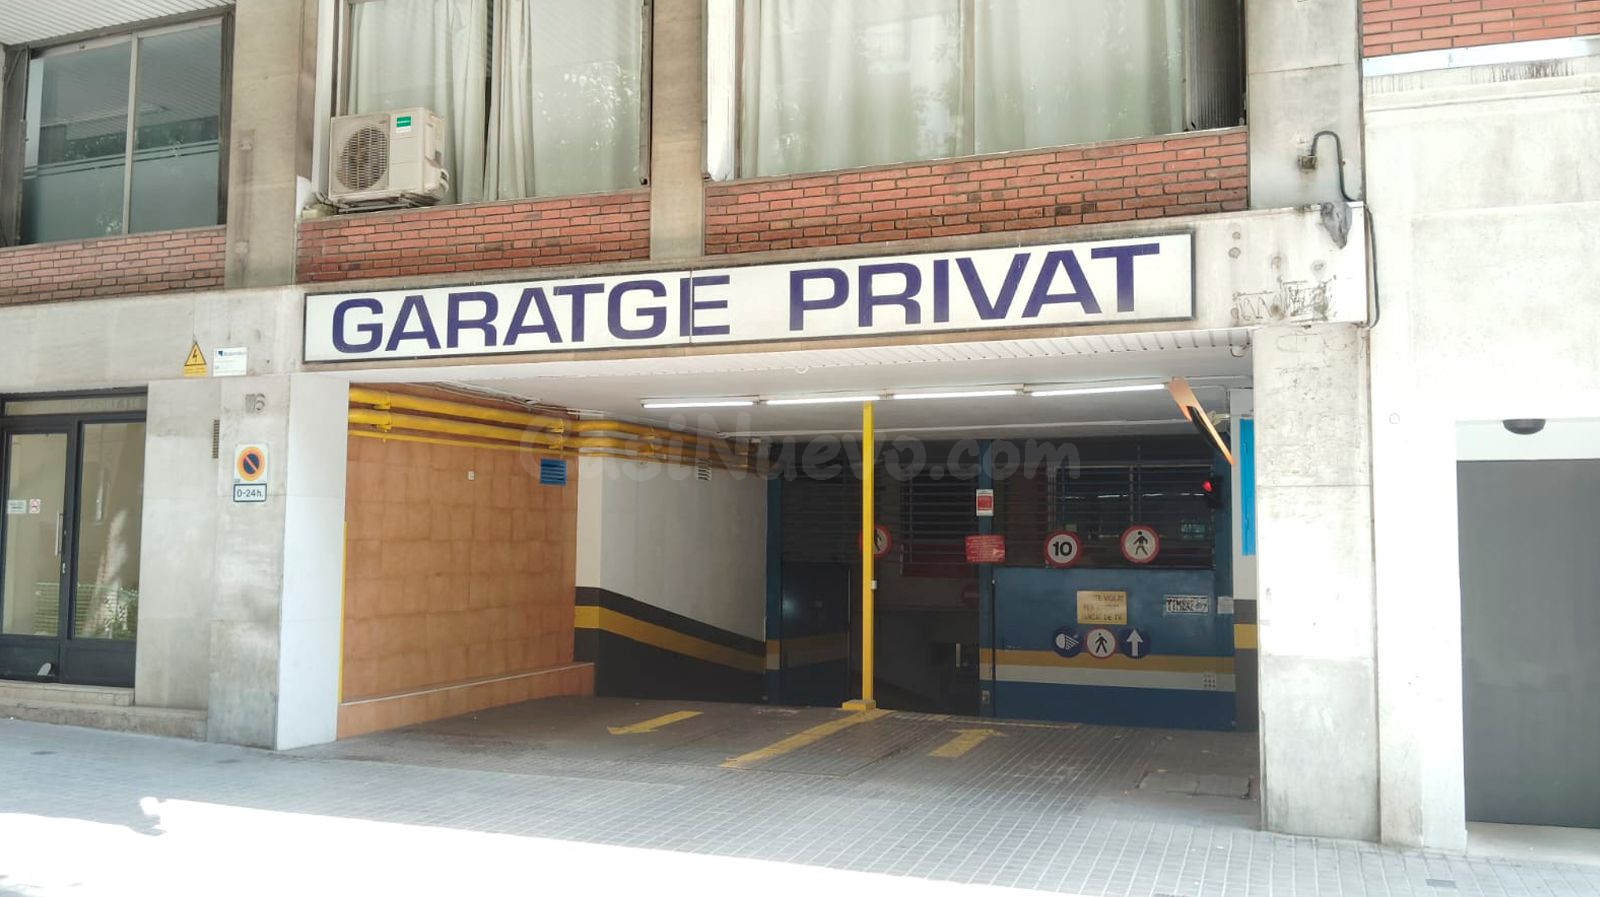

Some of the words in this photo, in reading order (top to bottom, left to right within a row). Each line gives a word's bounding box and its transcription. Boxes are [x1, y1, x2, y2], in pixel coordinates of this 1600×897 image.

[332, 274, 731, 354] GARATGE
[789, 242, 1160, 331] PRIVAT
[236, 487, 264, 498] 0-24h.
[1052, 541, 1073, 556] 10
